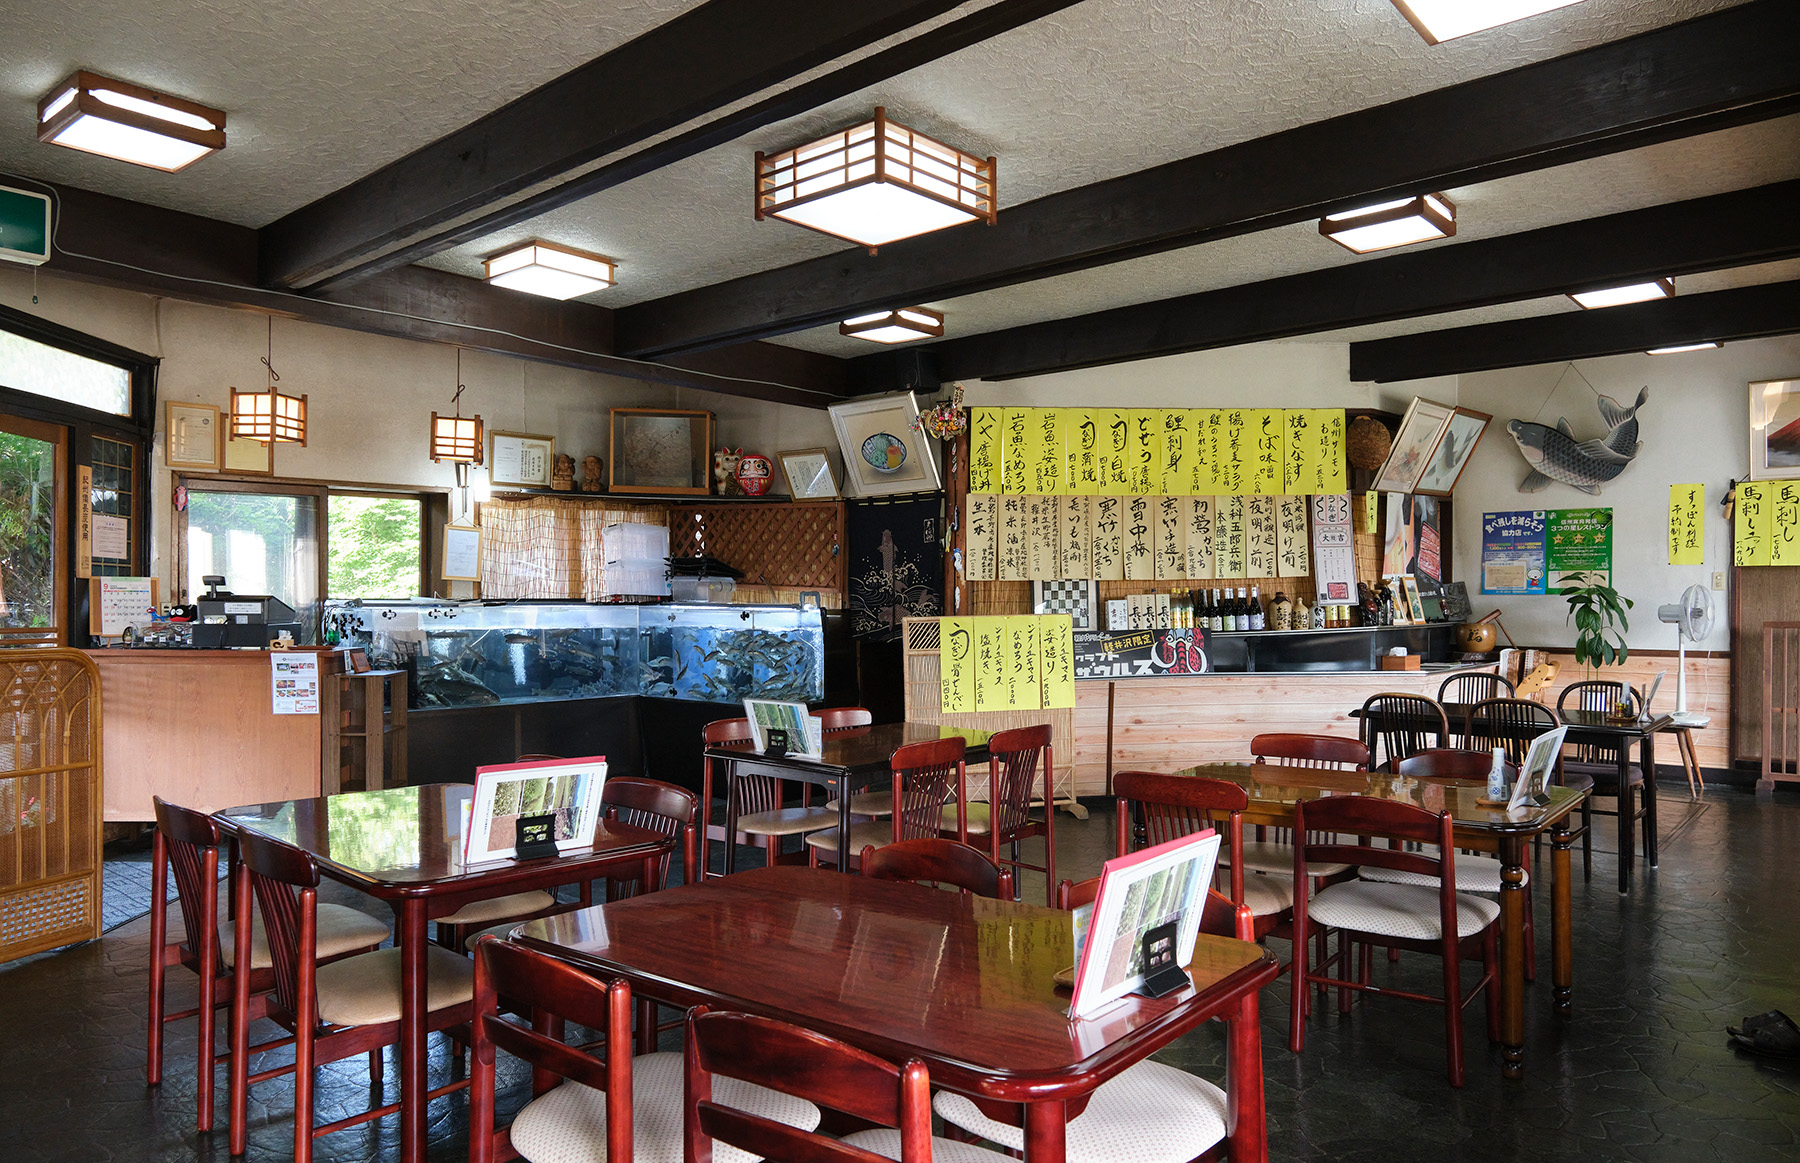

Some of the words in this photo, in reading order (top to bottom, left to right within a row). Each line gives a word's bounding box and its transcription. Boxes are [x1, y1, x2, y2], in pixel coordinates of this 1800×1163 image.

[1110, 413, 1128, 484] うなぎ白焼
[1163, 413, 1188, 473] 鯉刺身
[1288, 414, 1308, 483] 焼きなす
[1331, 416, 1342, 477] 信州サーモン
[1128, 497, 1151, 558] 雪中梅
[1249, 496, 1264, 569] 夜明け前
[1280, 501, 1296, 568] 夜明け前
[1740, 485, 1762, 557] 馬刺しユッケ
[1776, 485, 1800, 542] 馬刺し
[979, 634, 993, 675] 塩焼き
[1012, 630, 1023, 674] なめろう
[1075, 651, 1120, 662] クラフト
[1075, 660, 1155, 677] ザウルス
[1104, 634, 1152, 653] 軽井沢限定
